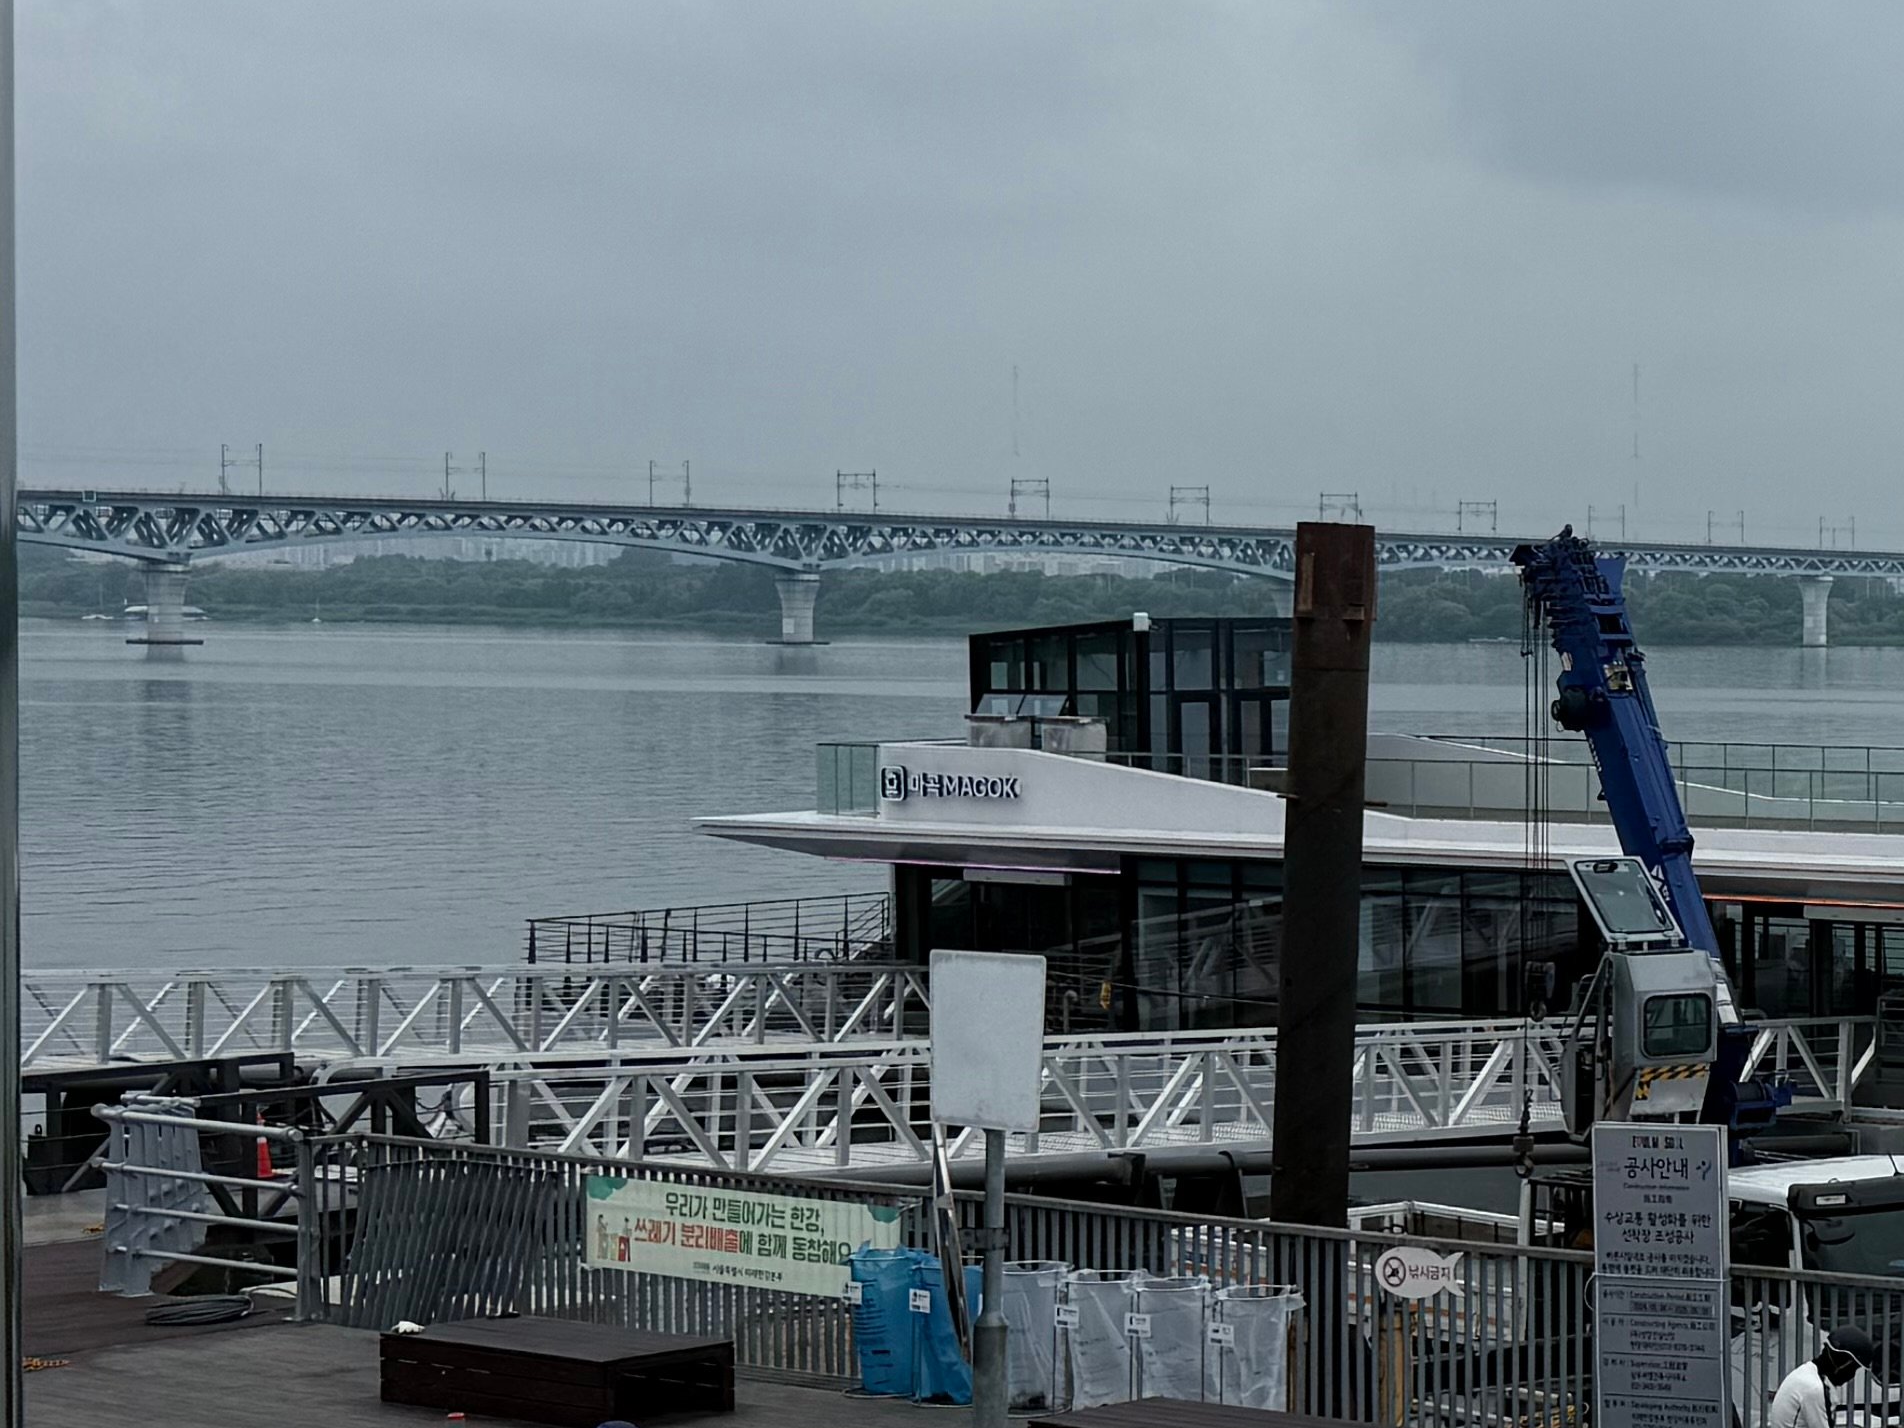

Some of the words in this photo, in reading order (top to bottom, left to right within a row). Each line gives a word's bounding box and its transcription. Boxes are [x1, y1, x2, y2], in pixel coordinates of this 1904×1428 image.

[943, 775, 1021, 799] MAGOK
[1624, 1156, 1689, 1181] 공사안내
[665, 1191, 708, 1221] 우리가
[712, 1198, 785, 1230] 만들어가는
[789, 1205, 825, 1238] 한강,
[634, 1216, 676, 1246] 쓰레기
[680, 1222, 752, 1256] 분리배출에
[757, 1233, 787, 1260] 함께
[1408, 1264, 1451, 1282] 낚시금지
